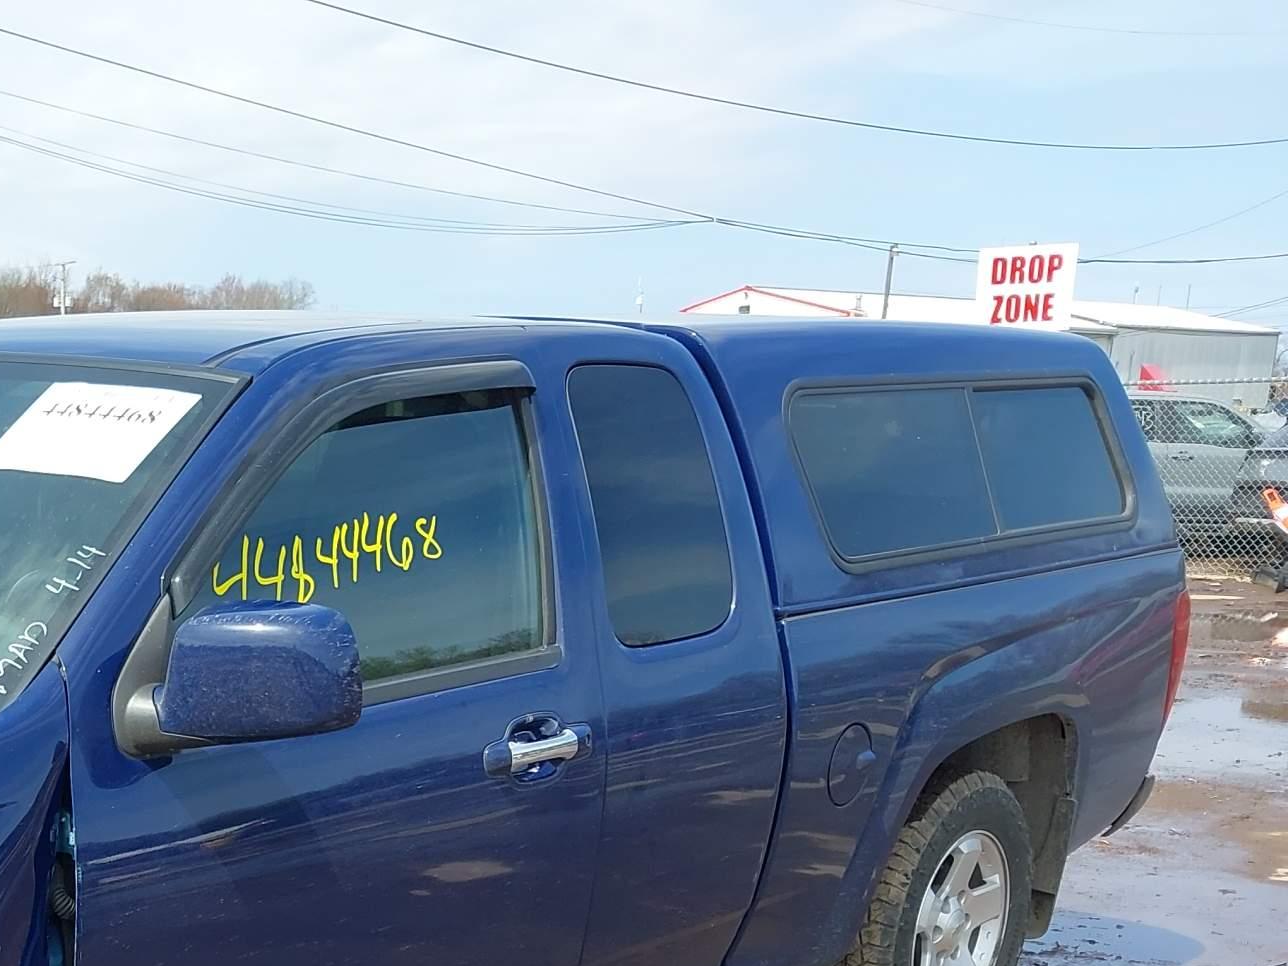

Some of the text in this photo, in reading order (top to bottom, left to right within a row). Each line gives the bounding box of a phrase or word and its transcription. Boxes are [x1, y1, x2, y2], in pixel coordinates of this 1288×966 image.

[991, 254, 1063, 284] DROP
[990, 293, 1055, 324] ZONE
[45, 543, 108, 594] 4-14
[213, 511, 443, 605] 44844468
